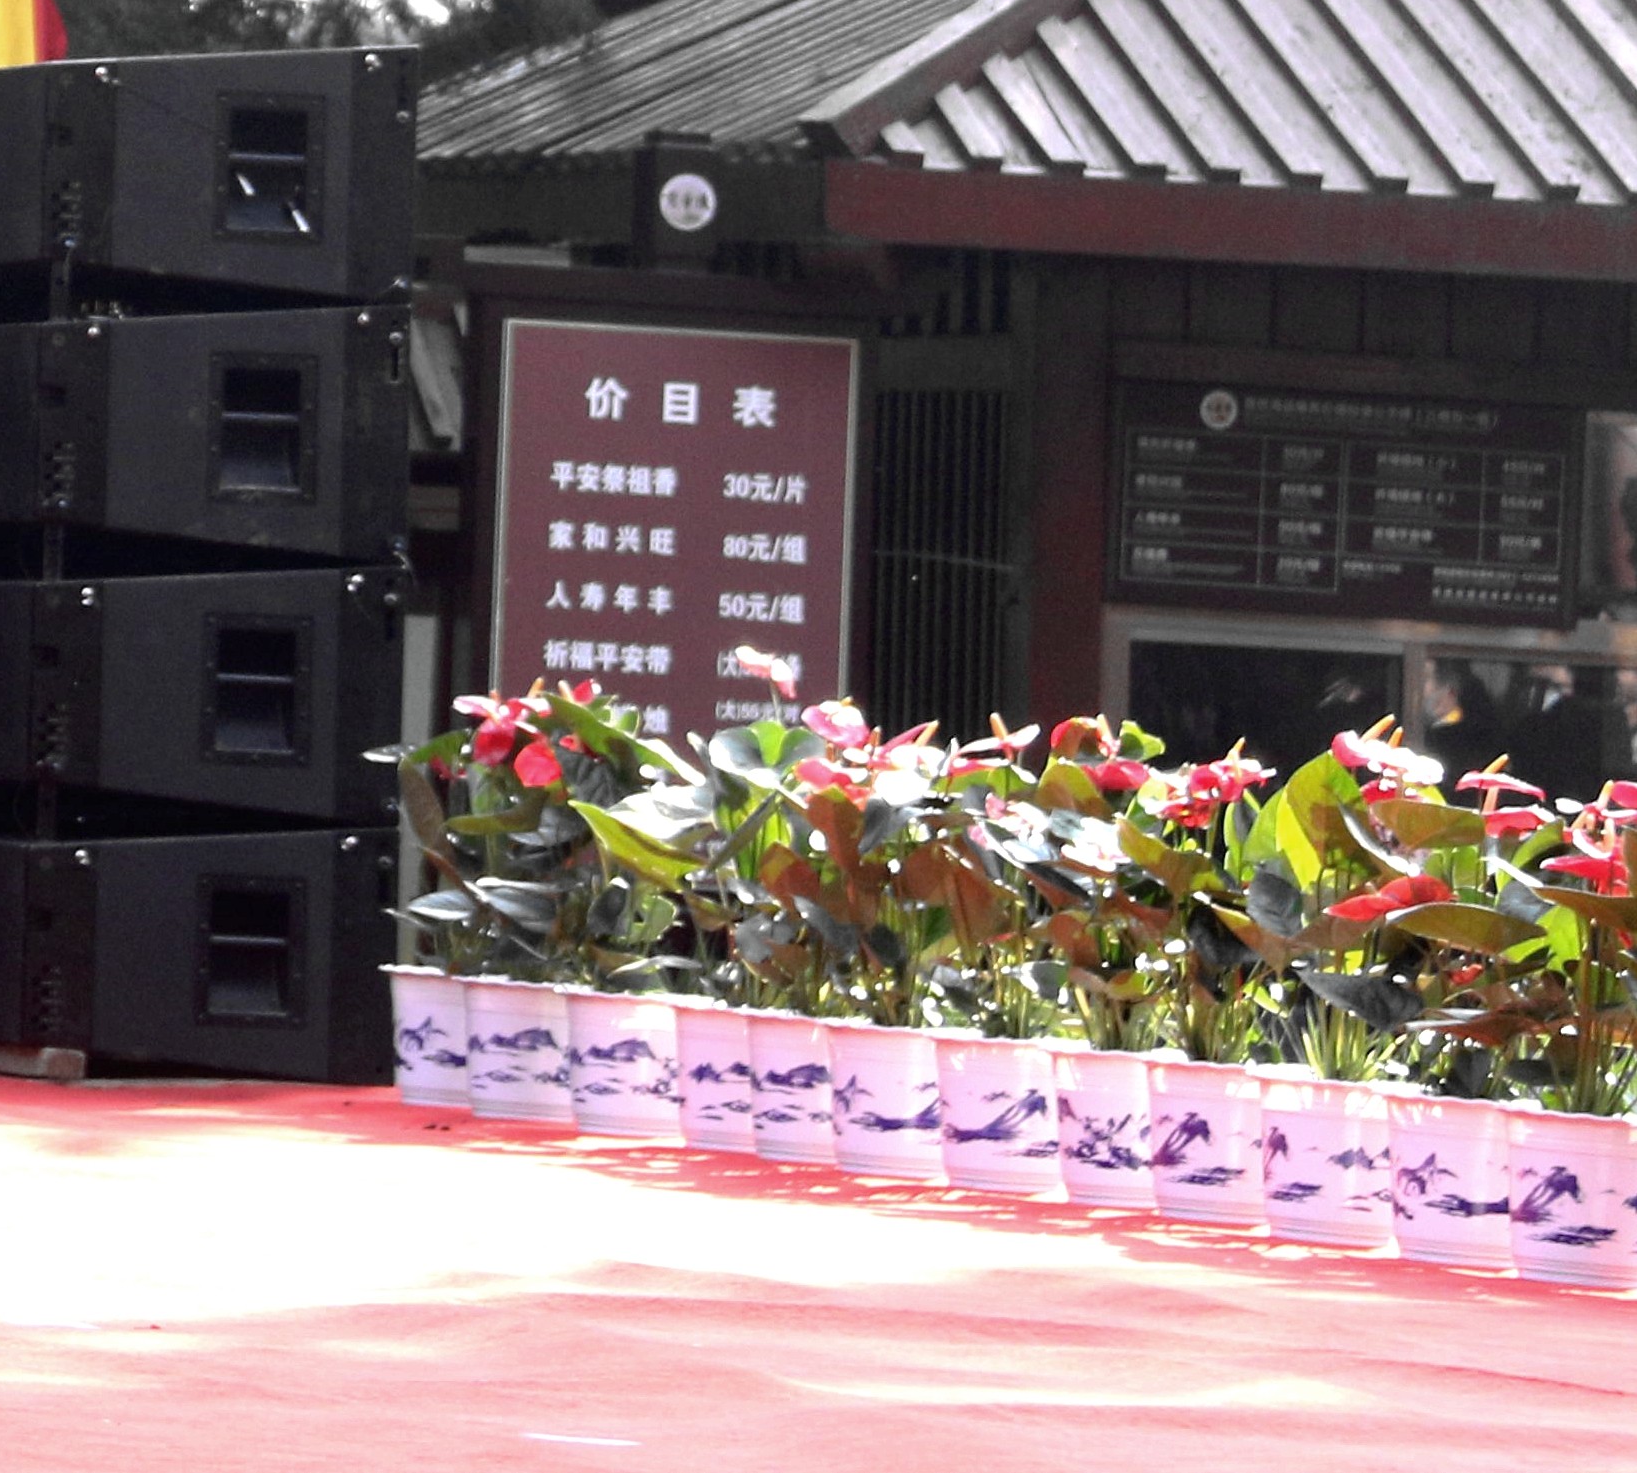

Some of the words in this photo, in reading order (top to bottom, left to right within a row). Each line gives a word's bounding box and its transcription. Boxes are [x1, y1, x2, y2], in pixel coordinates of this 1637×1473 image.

[584, 377, 776, 427] 价目表
[550, 461, 678, 497] 平安祭祖香
[723, 473, 807, 505] 30元/片
[548, 520, 676, 557] 家和兴旺
[723, 533, 807, 565] 80元/组
[545, 581, 674, 616] 人寿年丰
[719, 594, 805, 625] 50元/组
[544, 639, 672, 674] 祈福平安带
